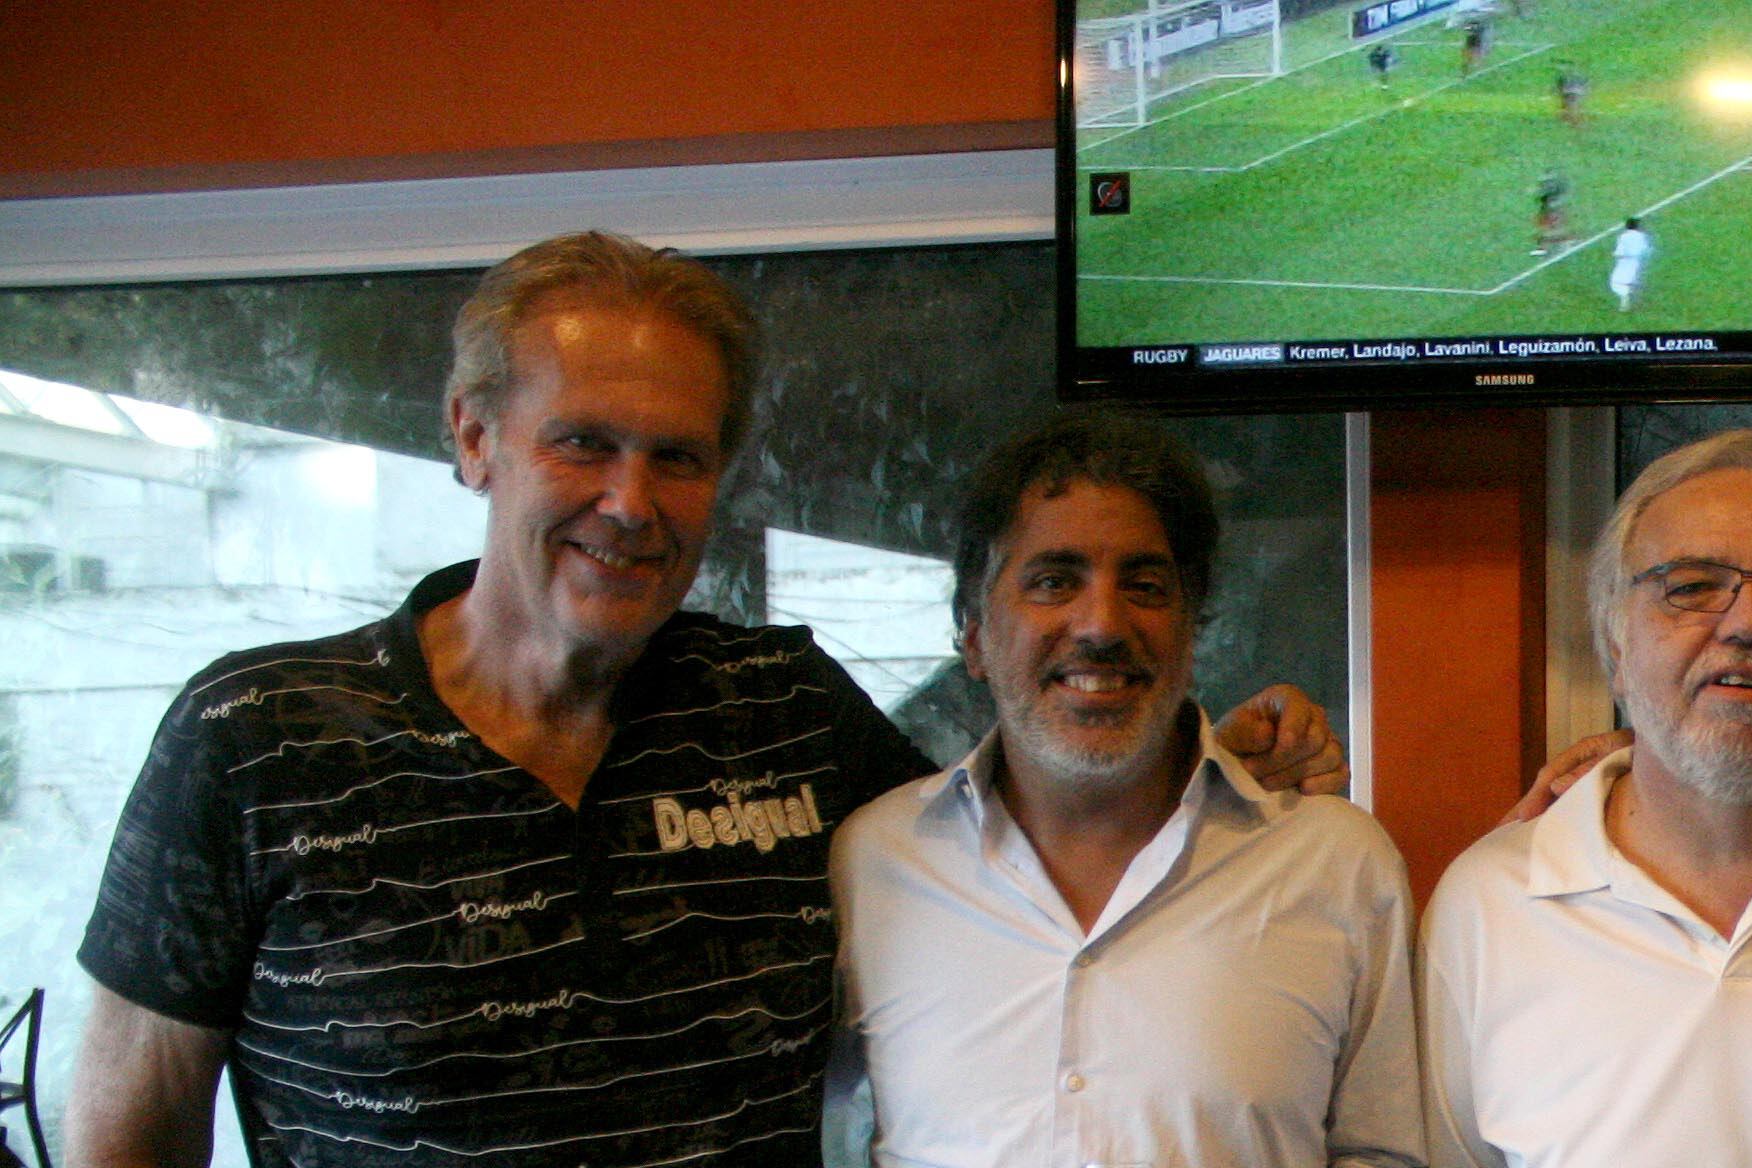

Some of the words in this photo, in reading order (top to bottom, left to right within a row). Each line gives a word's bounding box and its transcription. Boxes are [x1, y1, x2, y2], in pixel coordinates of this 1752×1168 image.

[1133, 350, 1188, 364] RUGBY
[1204, 344, 1281, 362] JAGUARES
[1290, 345, 1349, 360] Kremer,
[1353, 342, 1420, 362] Landajo,
[1475, 374, 1535, 386] SAMSUNG
[709, 770, 777, 796] Desigual
[652, 782, 823, 855] Desigual
[292, 824, 376, 856] Desigual
[459, 890, 546, 923] Desigual
[480, 989, 573, 1021] Desigual
[332, 1088, 419, 1115] Desigual
